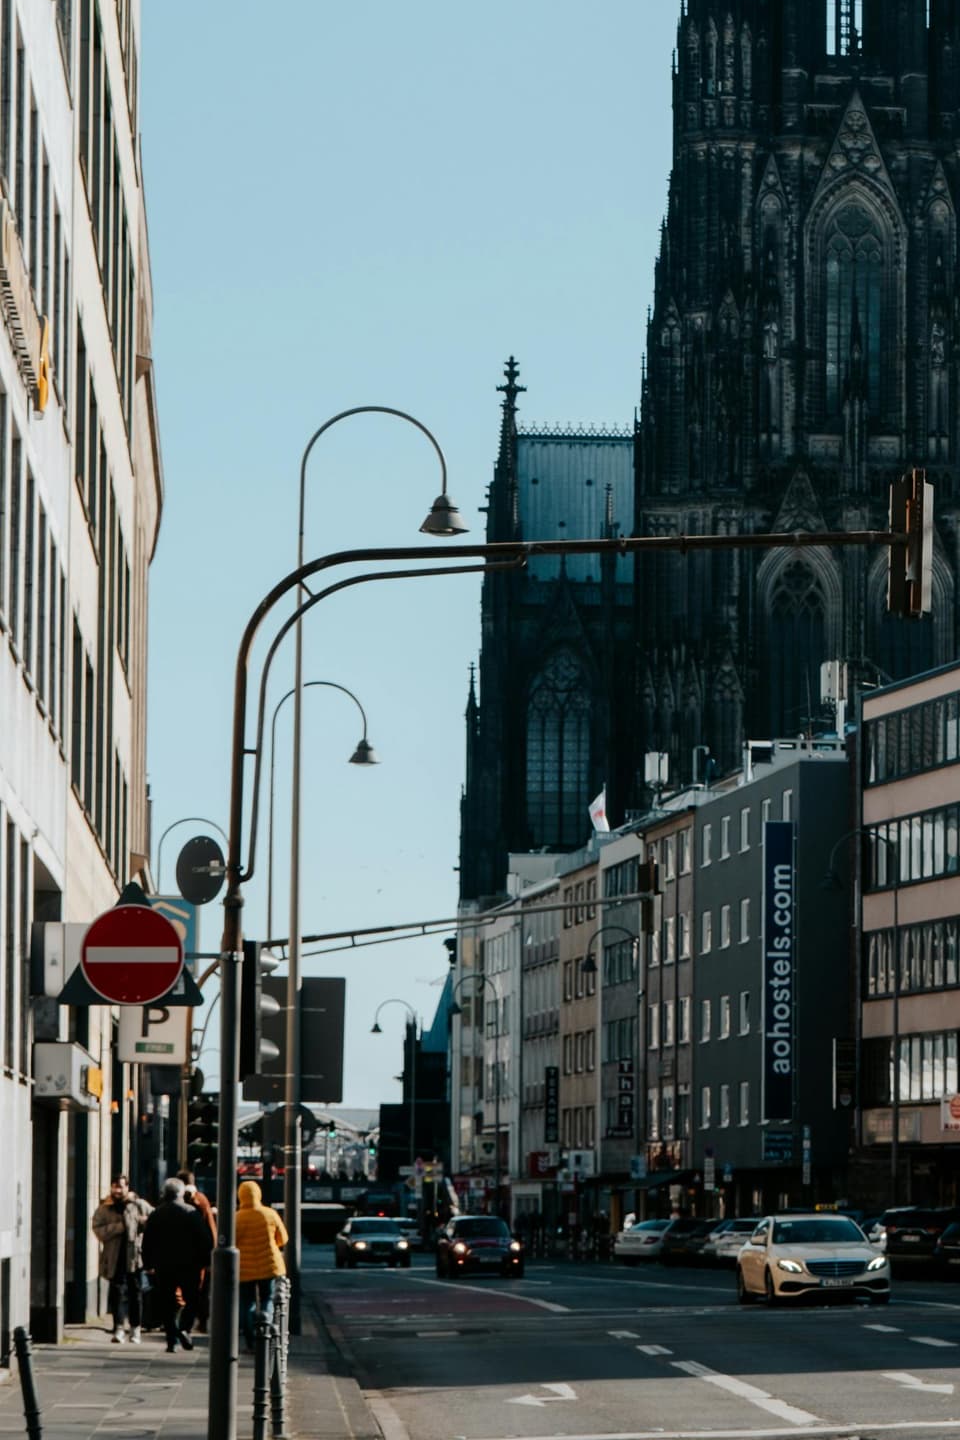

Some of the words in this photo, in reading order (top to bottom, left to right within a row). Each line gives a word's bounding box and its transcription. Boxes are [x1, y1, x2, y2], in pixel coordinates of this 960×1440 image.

[766, 864, 791, 1074] aohostels.com
[142, 1006, 169, 1037] P
[620, 1060, 633, 1127] Thai
